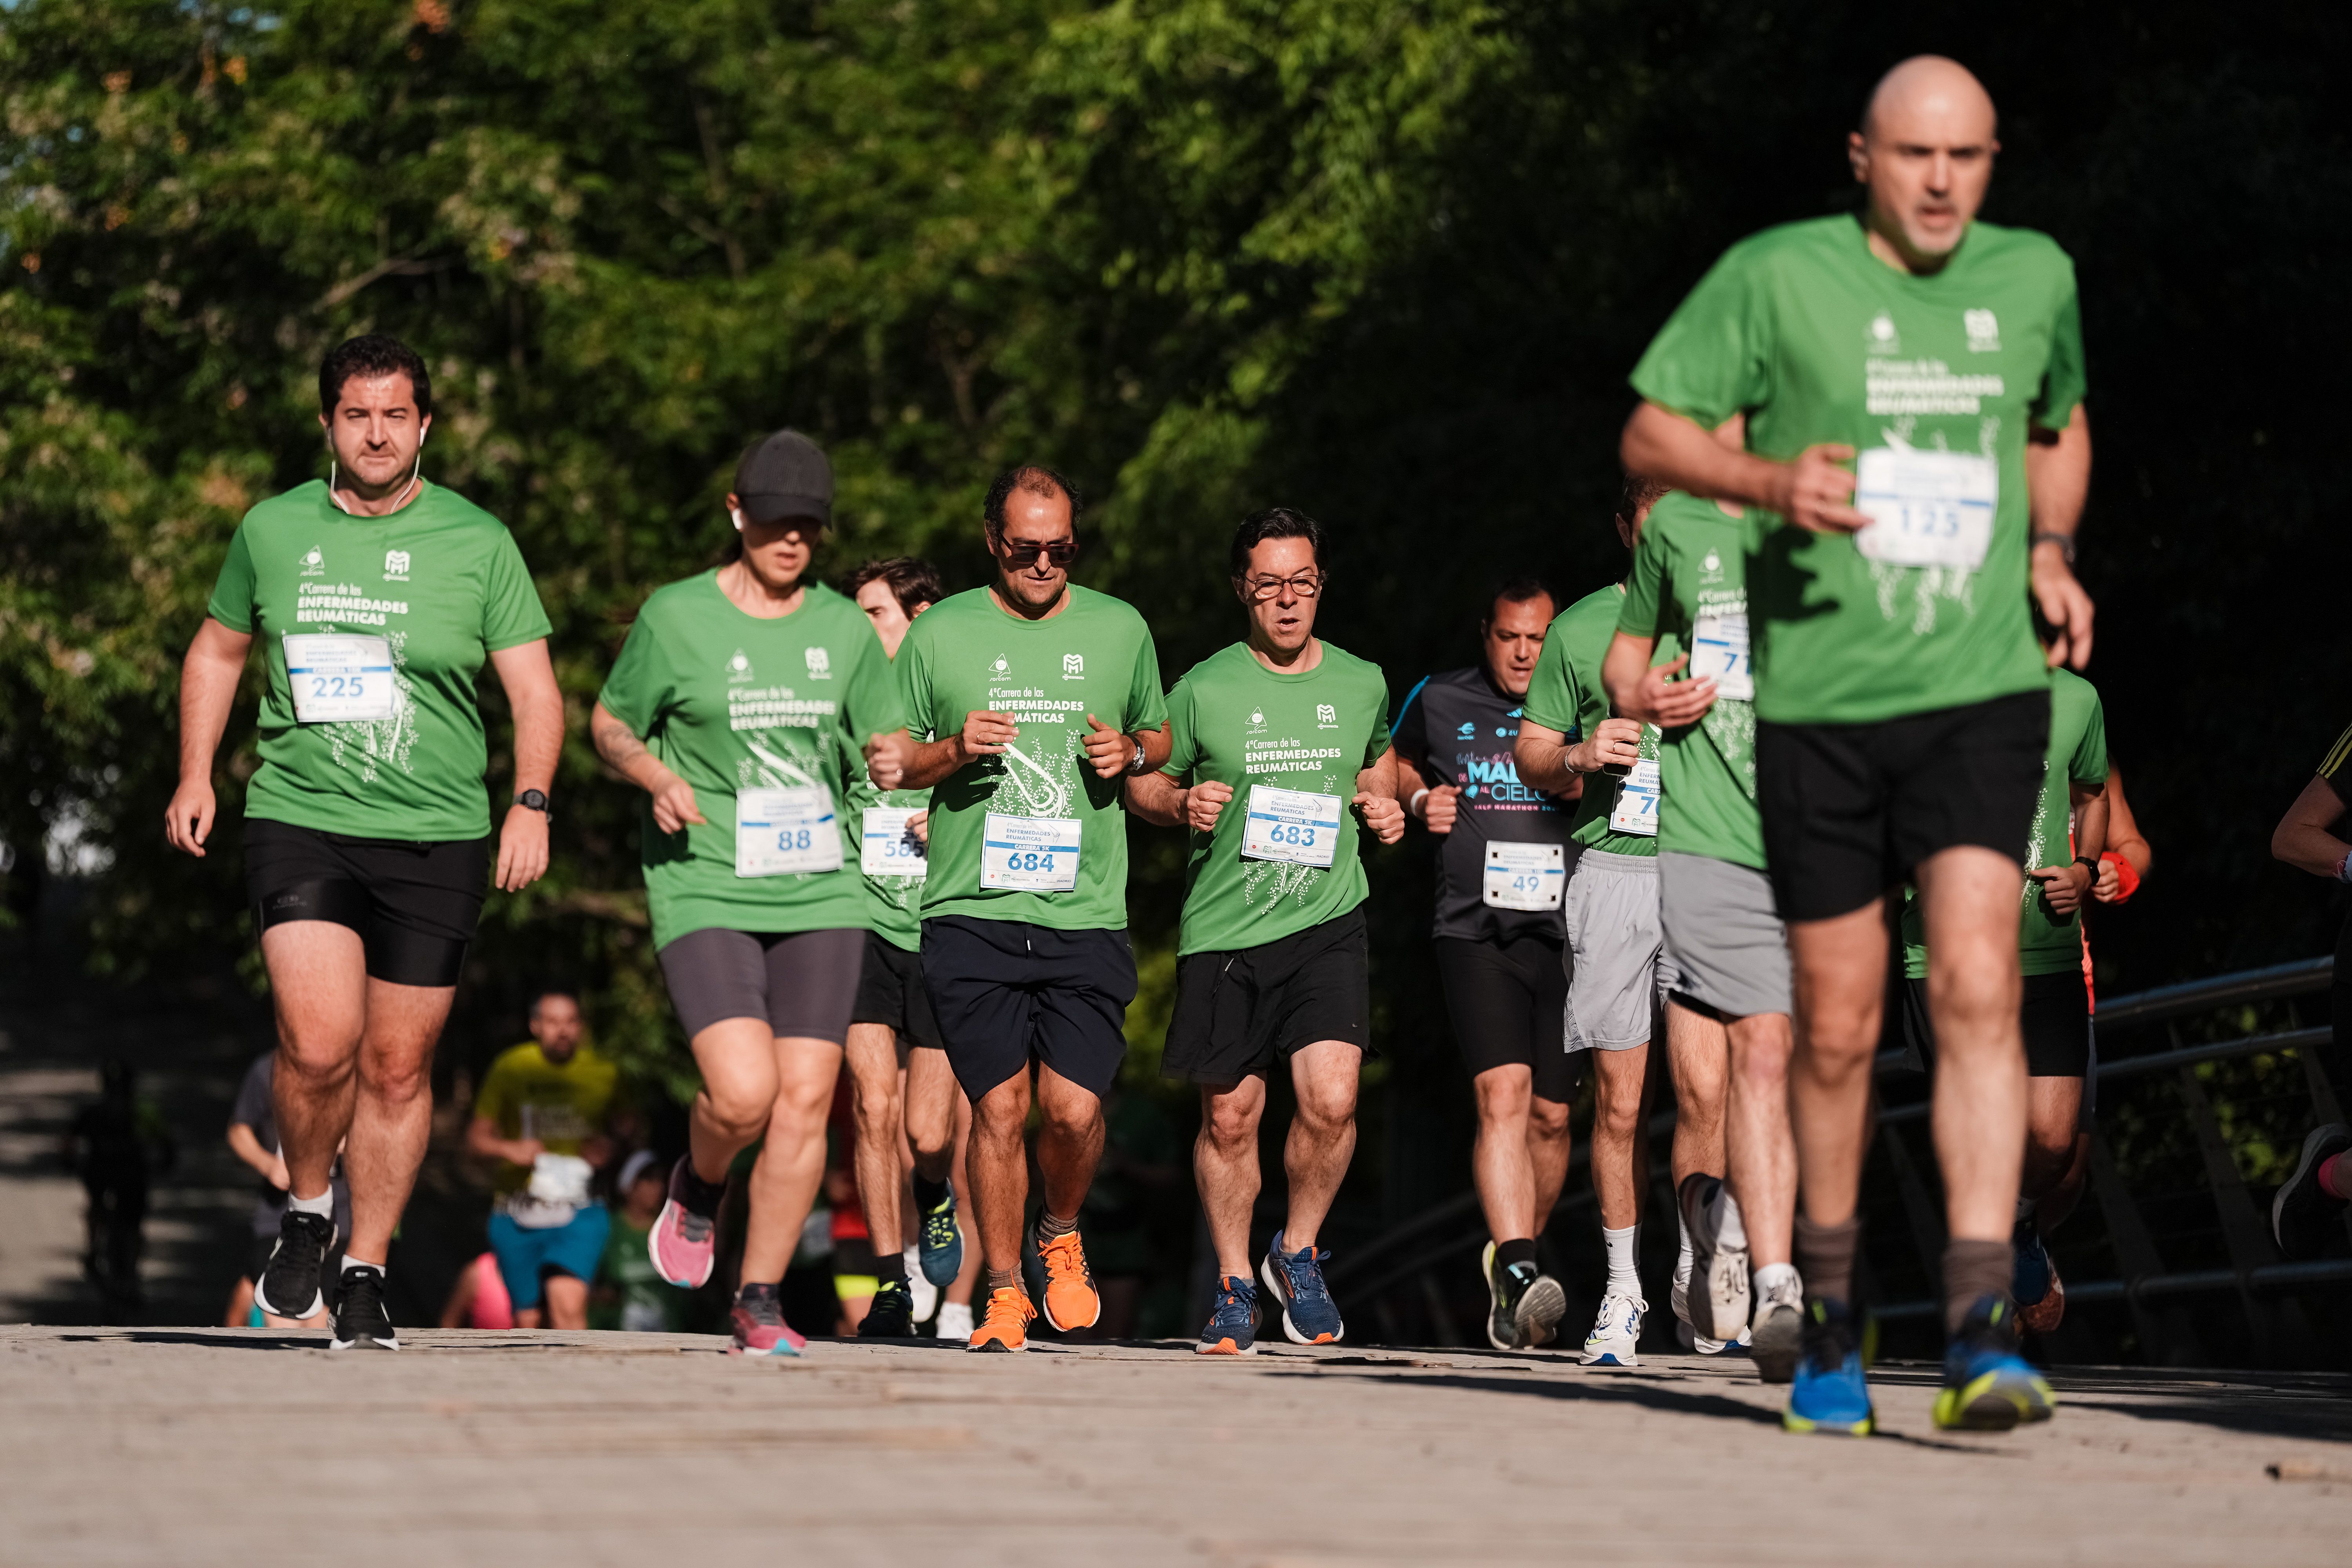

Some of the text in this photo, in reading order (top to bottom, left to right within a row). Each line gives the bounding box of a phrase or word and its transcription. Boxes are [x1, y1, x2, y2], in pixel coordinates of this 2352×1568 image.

[1903, 508, 1958, 539] 125
[337, 582, 348, 595] de
[350, 583, 362, 596] las
[298, 595, 408, 614] ENFERMEDADES
[312, 677, 364, 697] 225
[1023, 687, 1032, 697] de
[1034, 687, 1044, 697] las
[729, 700, 836, 717] ENFERMEDADES
[989, 700, 1084, 711] ENFERMEDADES
[1280, 738, 1289, 748] de
[1290, 737, 1300, 747] las
[1245, 748, 1341, 762] ENFERMEDADES
[1246, 760, 1322, 774] REUMÁTICAS
[1480, 785, 1490, 794] AL
[1271, 801, 1314, 810] ENFERMEDADES
[779, 831, 810, 851] 88
[1270, 824, 1315, 846] 683
[885, 840, 924, 857] 585
[1008, 853, 1054, 872] 684
[1512, 876, 1539, 892] 49
